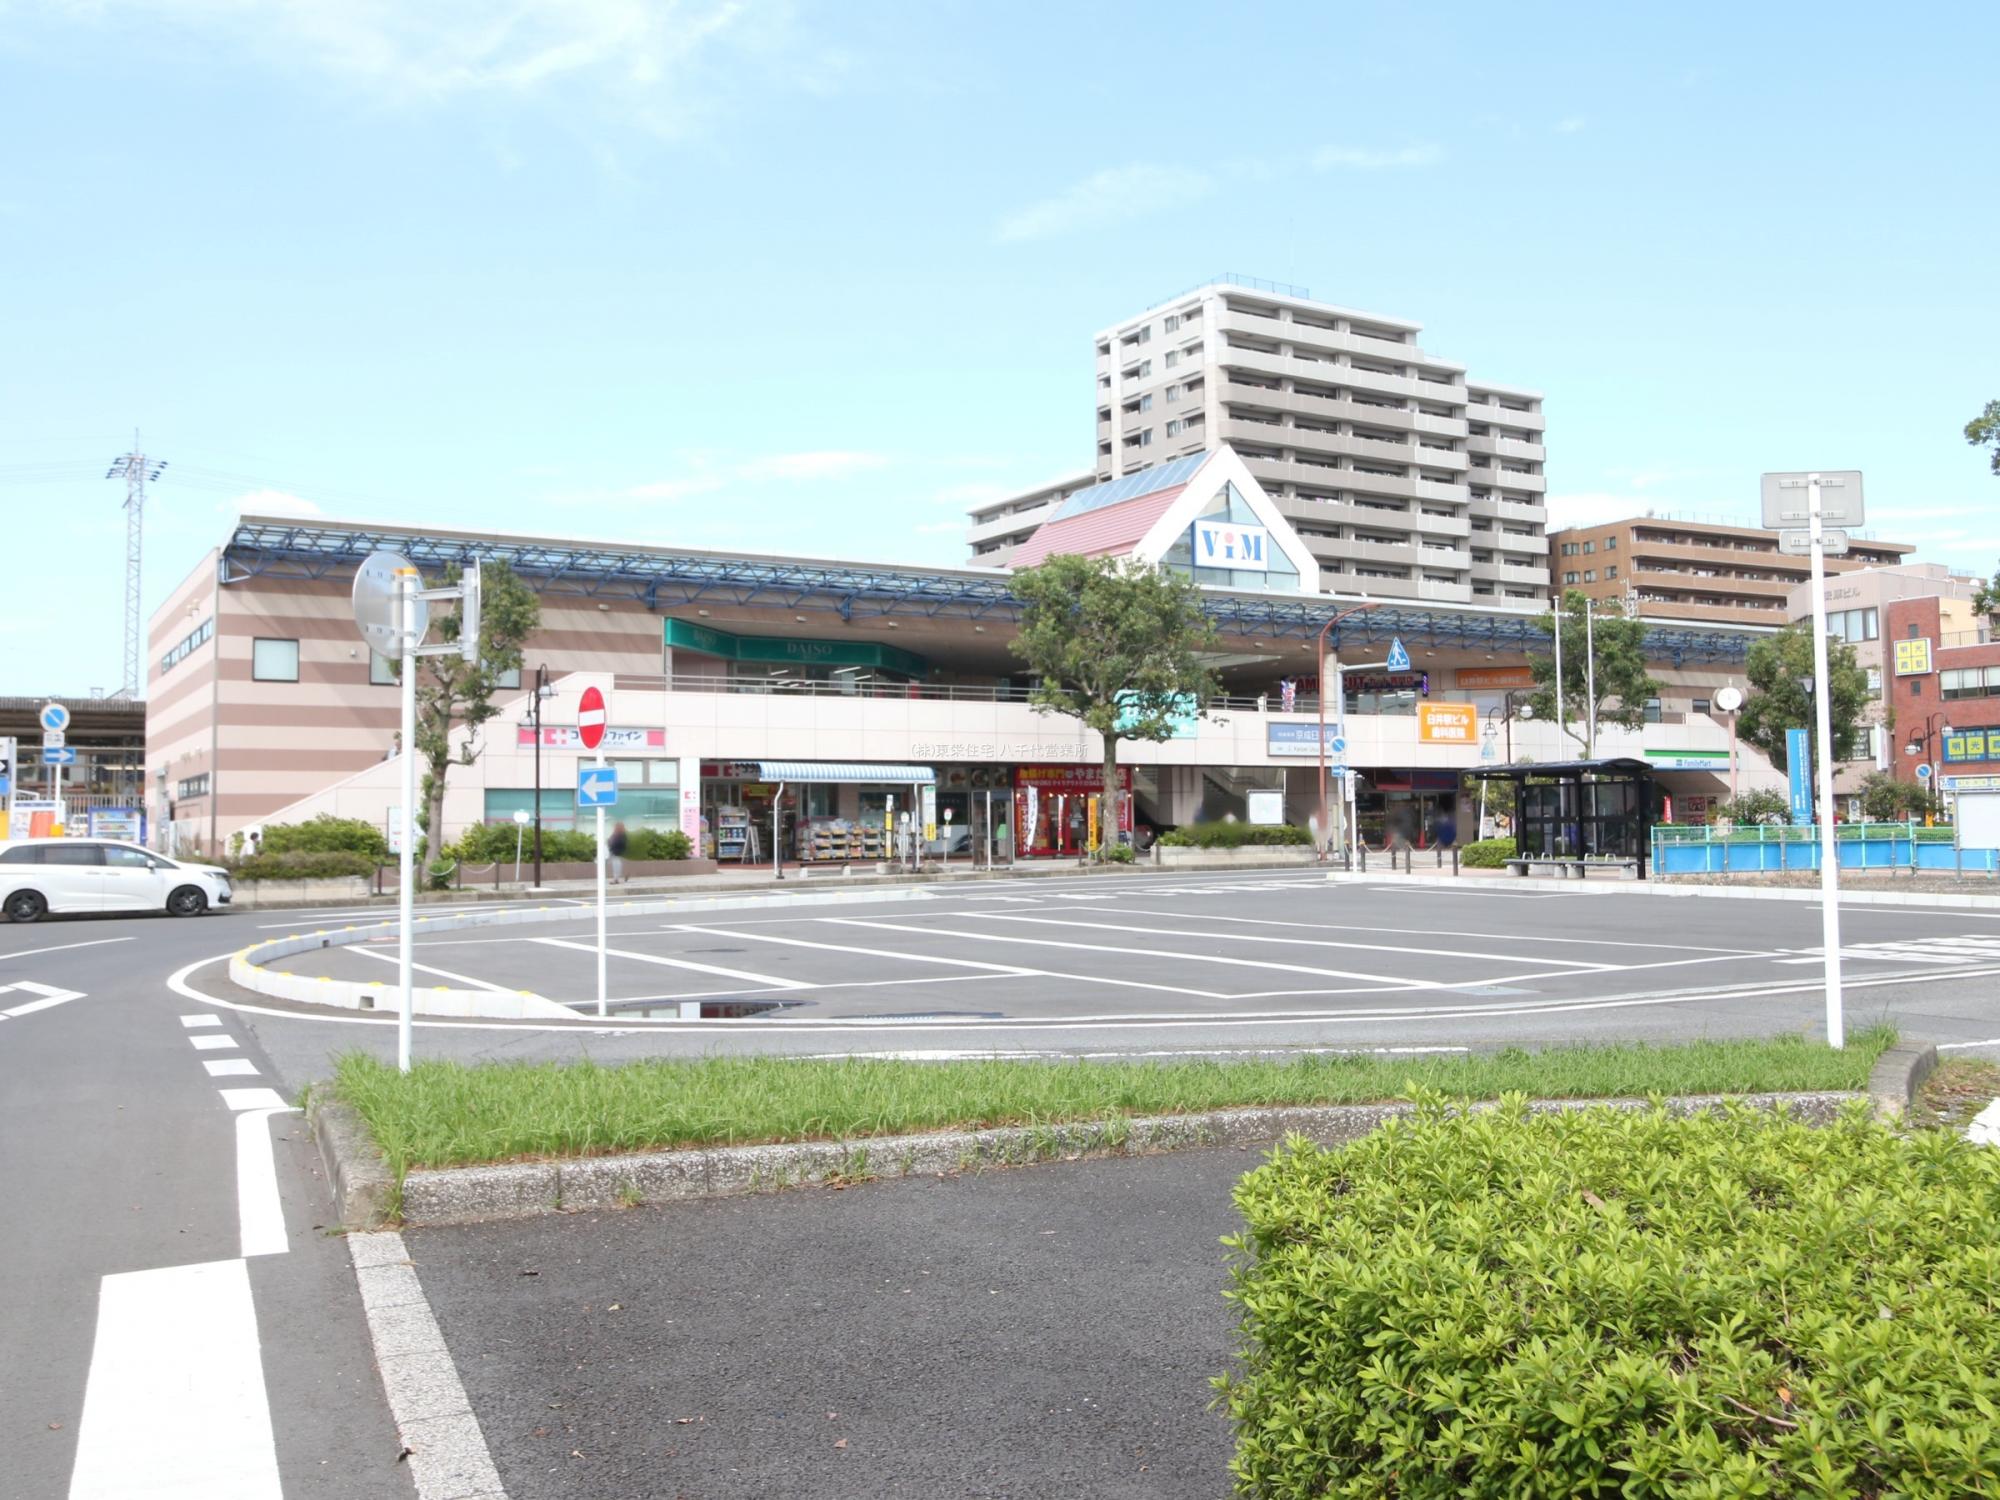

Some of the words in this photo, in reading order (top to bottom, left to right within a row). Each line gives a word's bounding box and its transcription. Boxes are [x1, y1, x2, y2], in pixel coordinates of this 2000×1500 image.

[786, 642, 833, 656] DAISO
[571, 730, 642, 742] コファイン
[1683, 760, 1712, 769] FamilyMart
